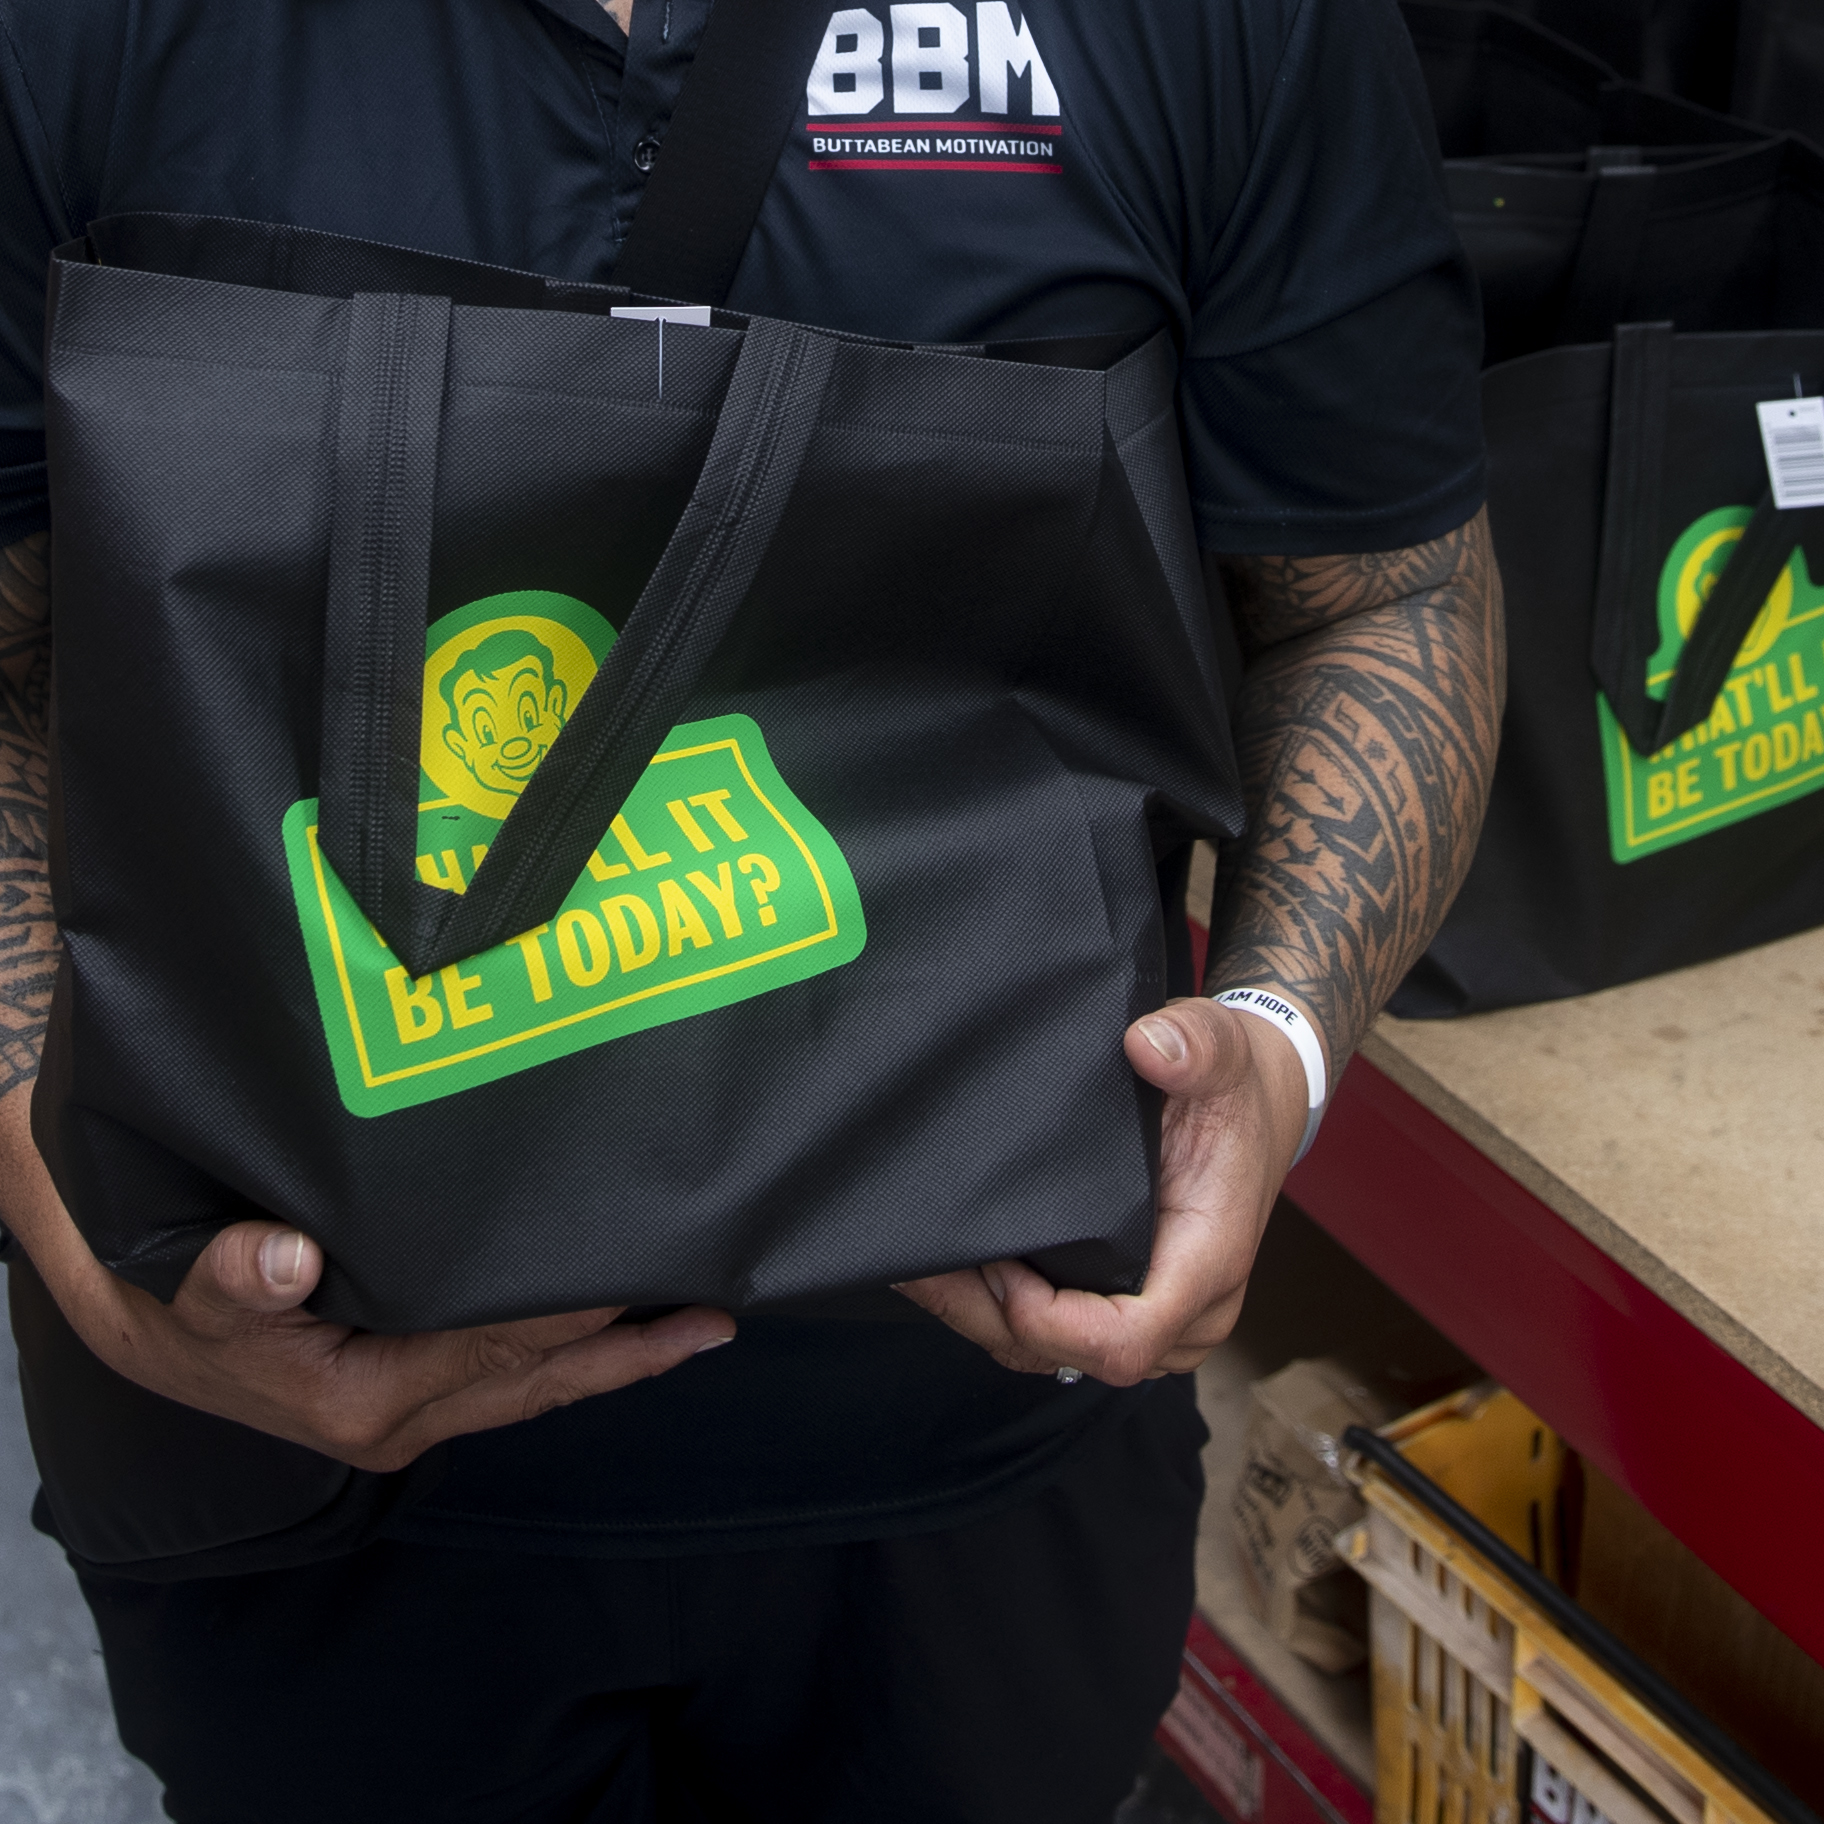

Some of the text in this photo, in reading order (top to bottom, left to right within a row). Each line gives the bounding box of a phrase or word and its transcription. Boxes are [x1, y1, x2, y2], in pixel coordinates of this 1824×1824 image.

[805, 0, 1061, 117] BBM
[812, 137, 1054, 157] BUTTABEAN MOTIVATION
[1650, 651, 1819, 764] AT'LL
[666, 788, 750, 854] IT
[1647, 758, 1704, 819] BE
[384, 852, 782, 1046] BE TODAY?
[1223, 990, 1254, 1003] AM
[1254, 993, 1299, 1027] HOPE
